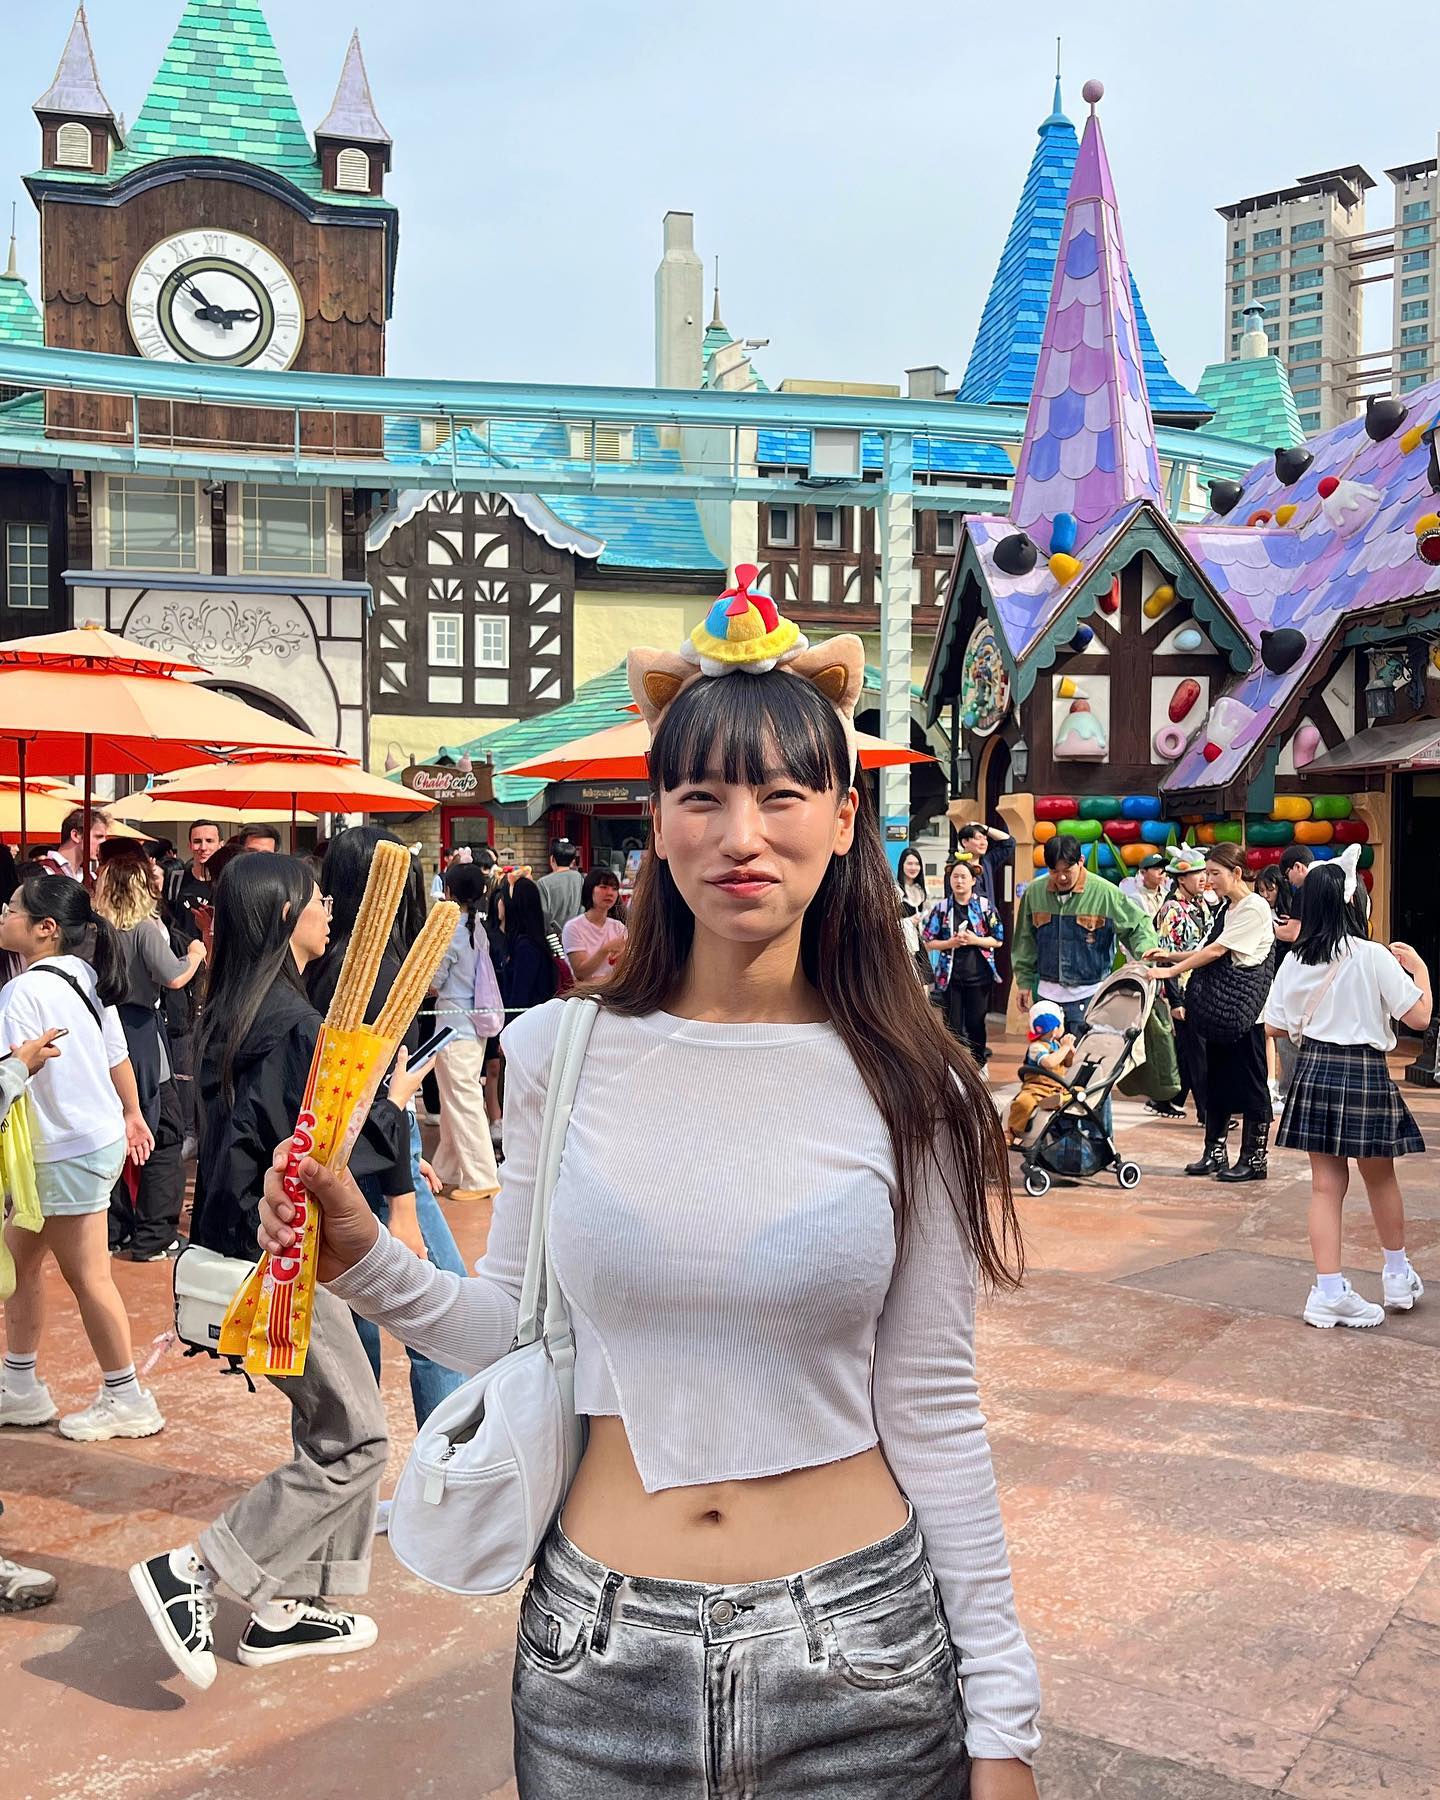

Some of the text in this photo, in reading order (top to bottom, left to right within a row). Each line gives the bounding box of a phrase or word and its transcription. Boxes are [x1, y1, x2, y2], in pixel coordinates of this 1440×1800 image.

[202, 233, 228, 257] XII
[413, 771, 478, 792] Chalet cafe
